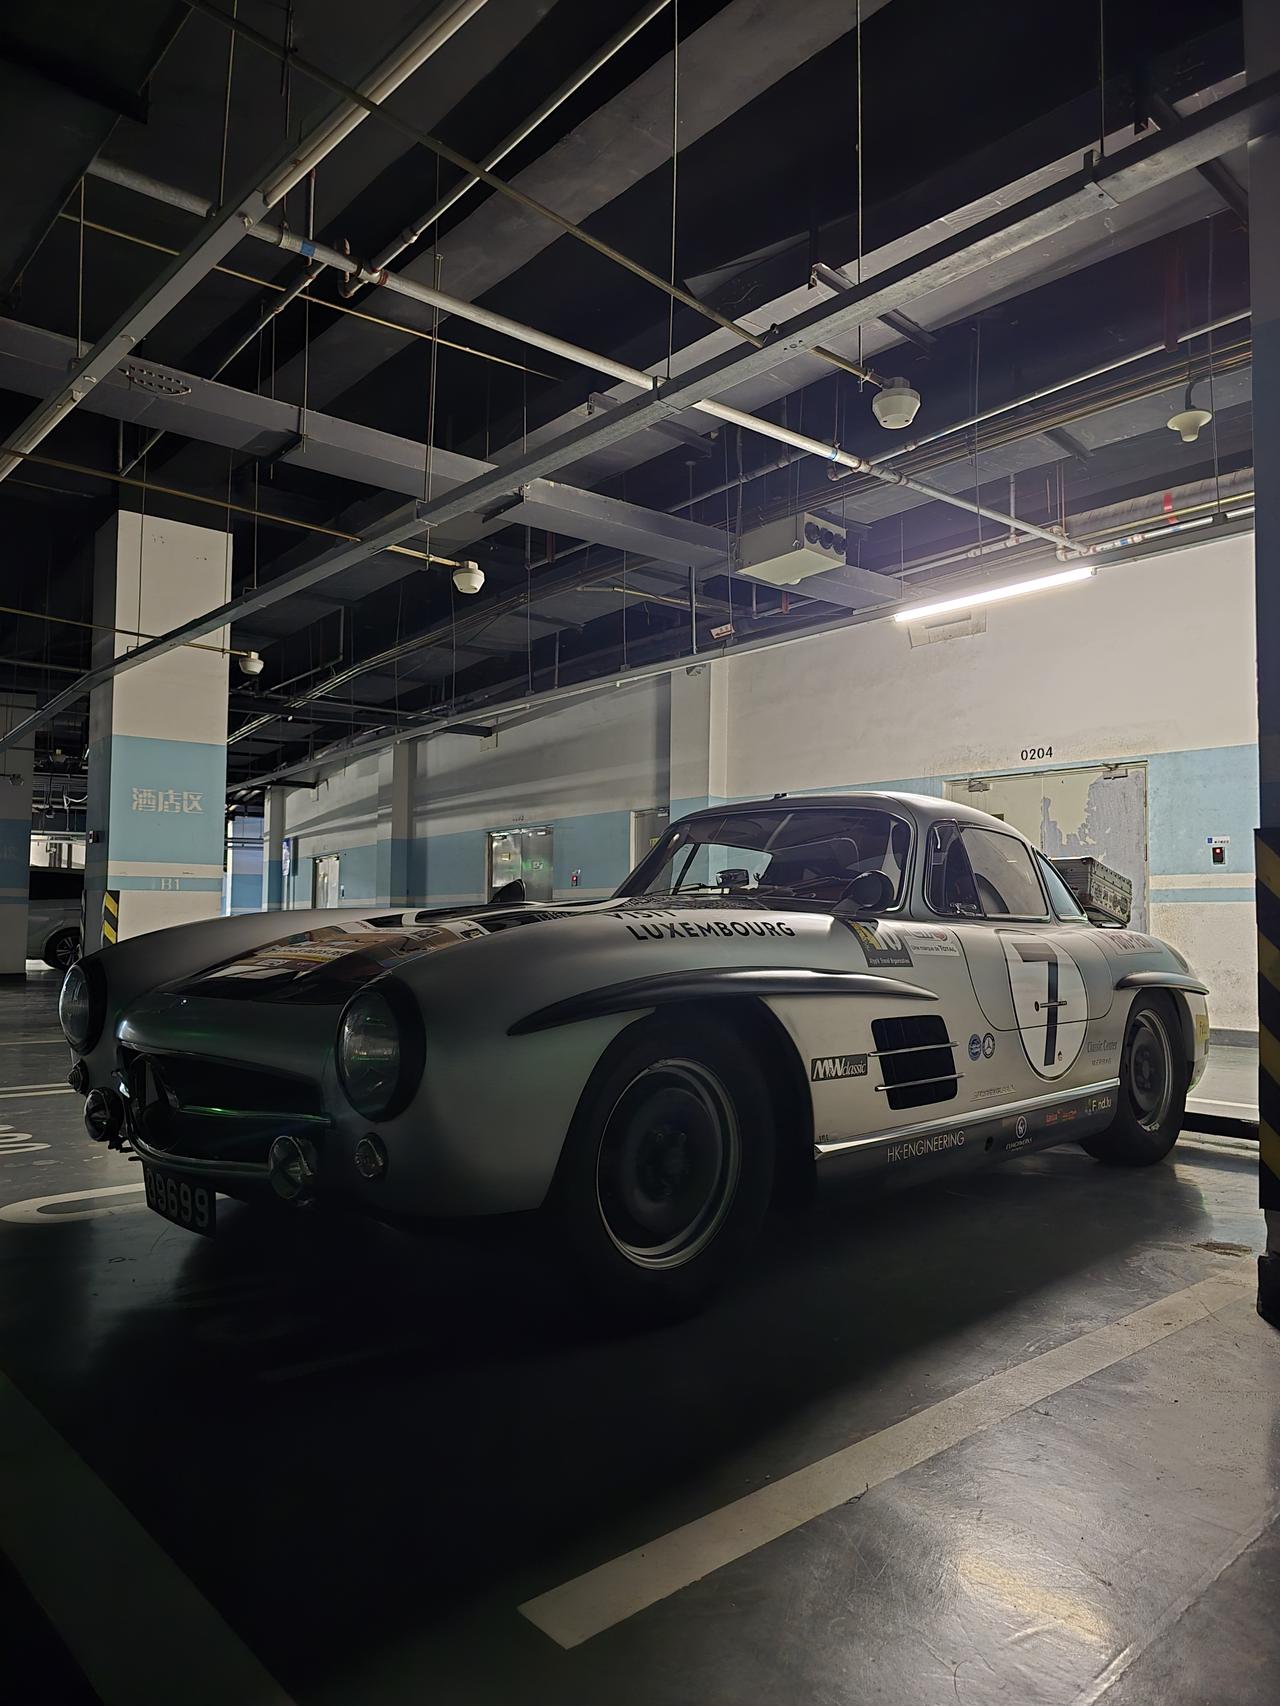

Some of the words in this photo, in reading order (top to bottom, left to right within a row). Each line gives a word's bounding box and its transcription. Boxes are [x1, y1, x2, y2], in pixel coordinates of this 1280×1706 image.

[1020, 746, 1053, 761] 0204
[131, 787, 204, 815] 酒店区
[626, 921, 796, 941] LUXEMBOURG
[1011, 942, 1059, 1067] 7
[887, 1131, 965, 1163] HK-ENGINEERING
